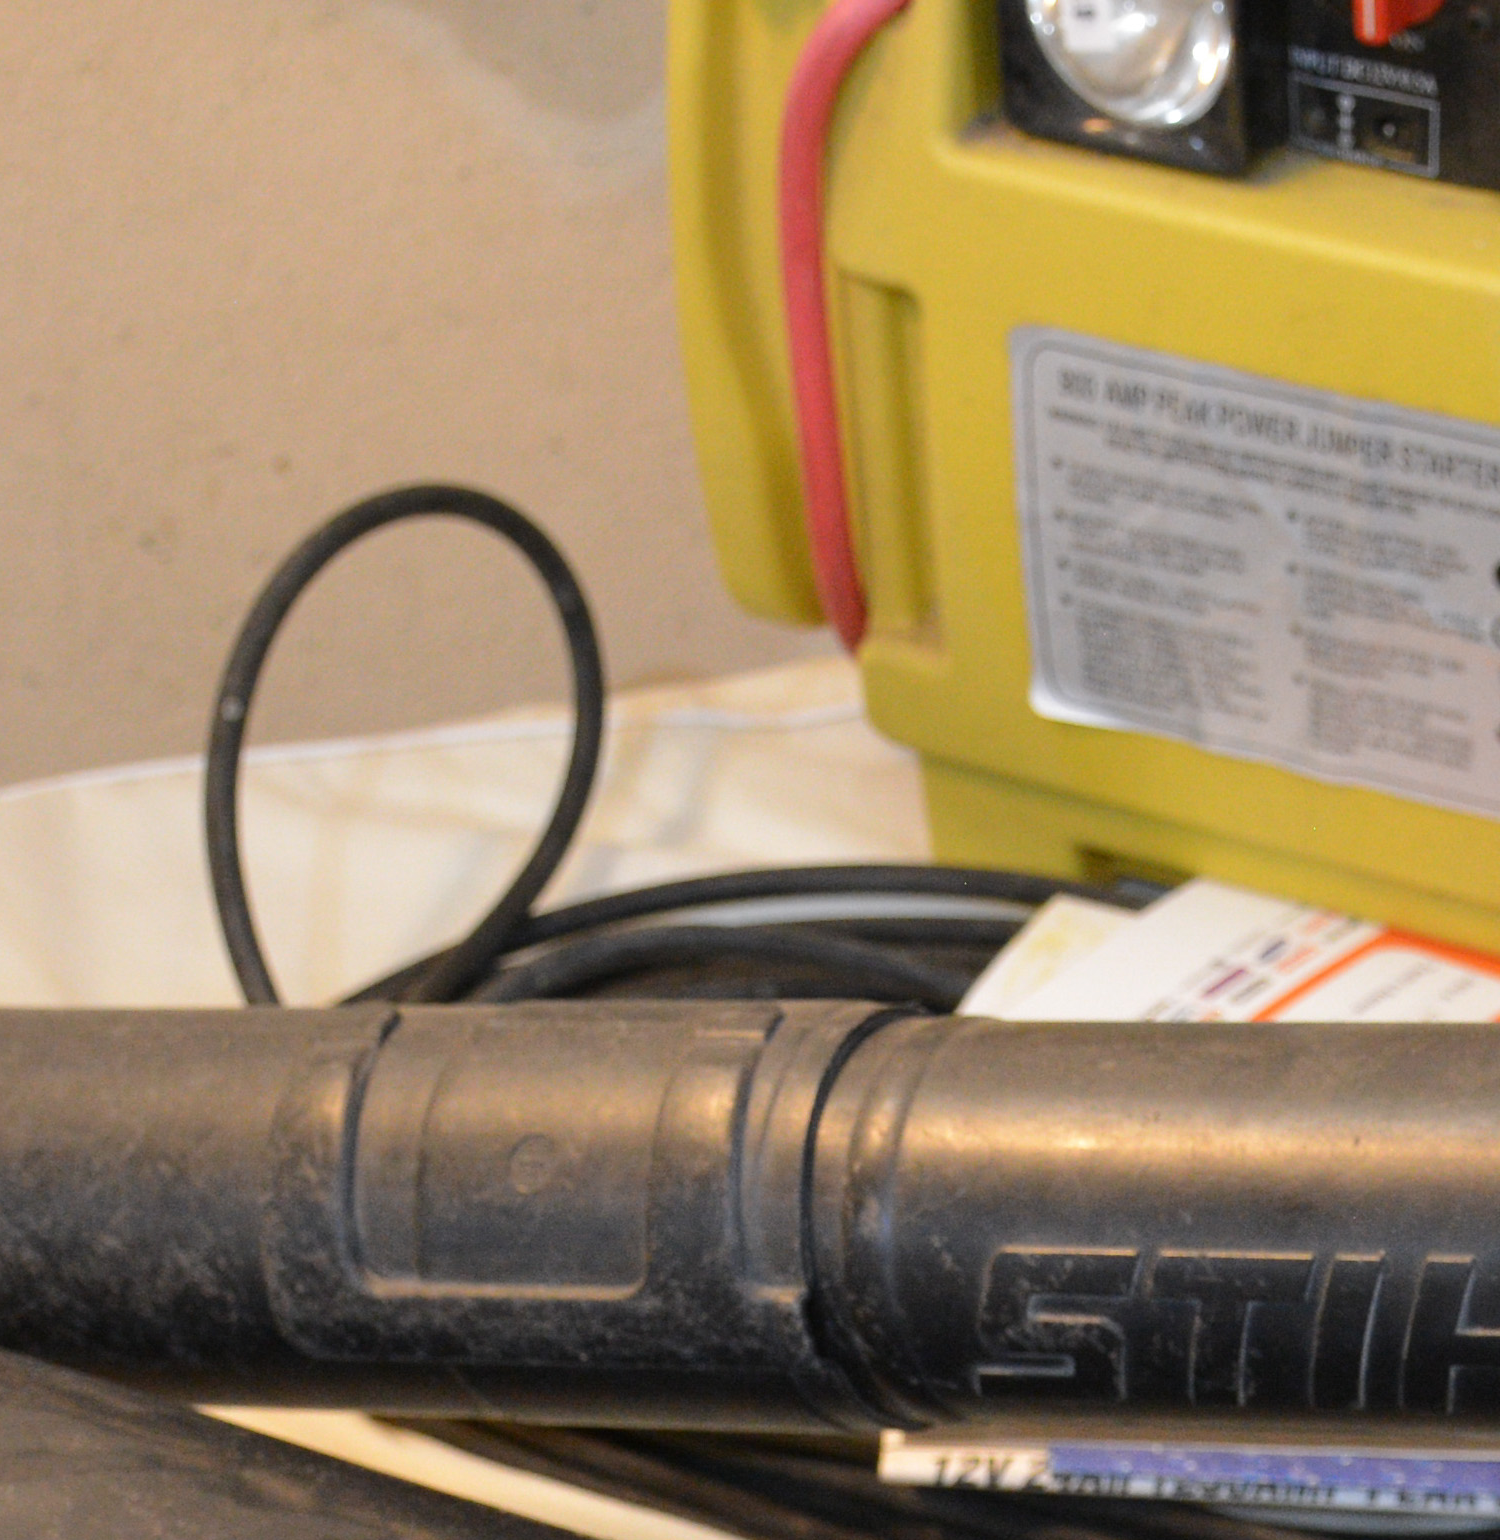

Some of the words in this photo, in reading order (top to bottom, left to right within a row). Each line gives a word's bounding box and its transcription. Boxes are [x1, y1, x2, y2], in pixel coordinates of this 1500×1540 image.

[1153, 387, 1211, 425] PEAK
[1215, 400, 1301, 445] POWER
[1305, 420, 1395, 469] JUMPER
